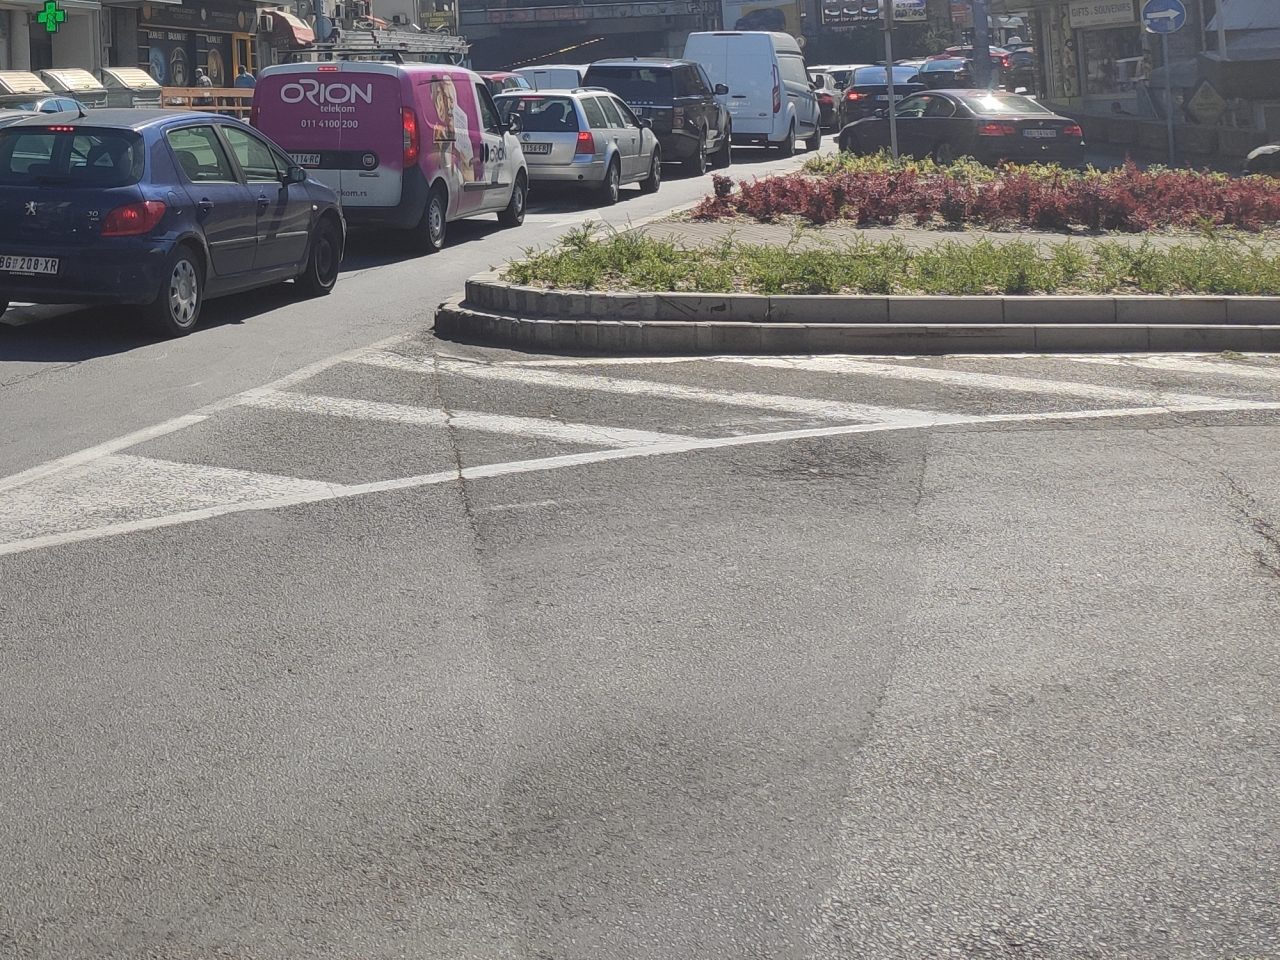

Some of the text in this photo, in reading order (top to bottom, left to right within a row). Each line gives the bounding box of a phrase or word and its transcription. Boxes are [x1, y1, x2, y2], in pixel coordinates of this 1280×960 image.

[1071, 2, 1132, 17] GIFTS SOUVENIRS
[280, 79, 373, 106] ORION
[320, 104, 355, 113] telekom
[301, 119, 359, 129] 011 4100 200
